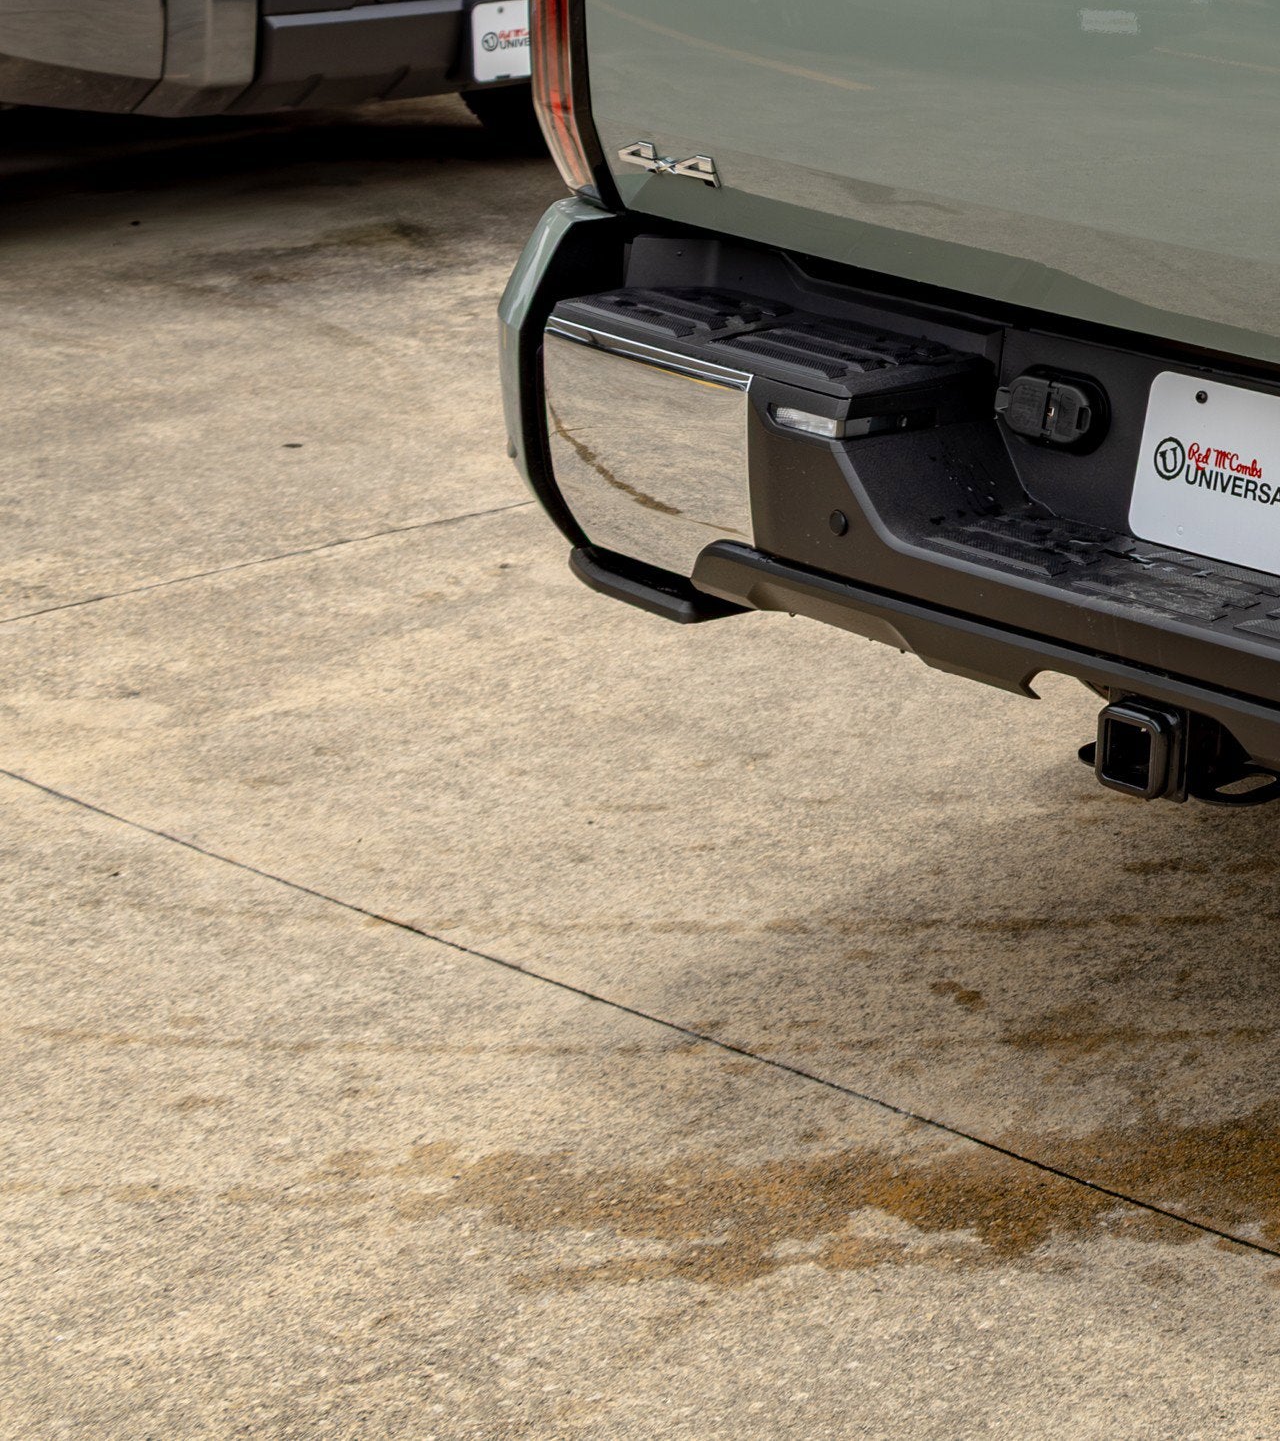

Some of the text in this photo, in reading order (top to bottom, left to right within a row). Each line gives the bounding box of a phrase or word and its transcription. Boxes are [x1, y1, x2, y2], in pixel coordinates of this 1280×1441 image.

[500, 37, 531, 49] UNIVE
[1188, 442, 1262, 479] Red McCombs
